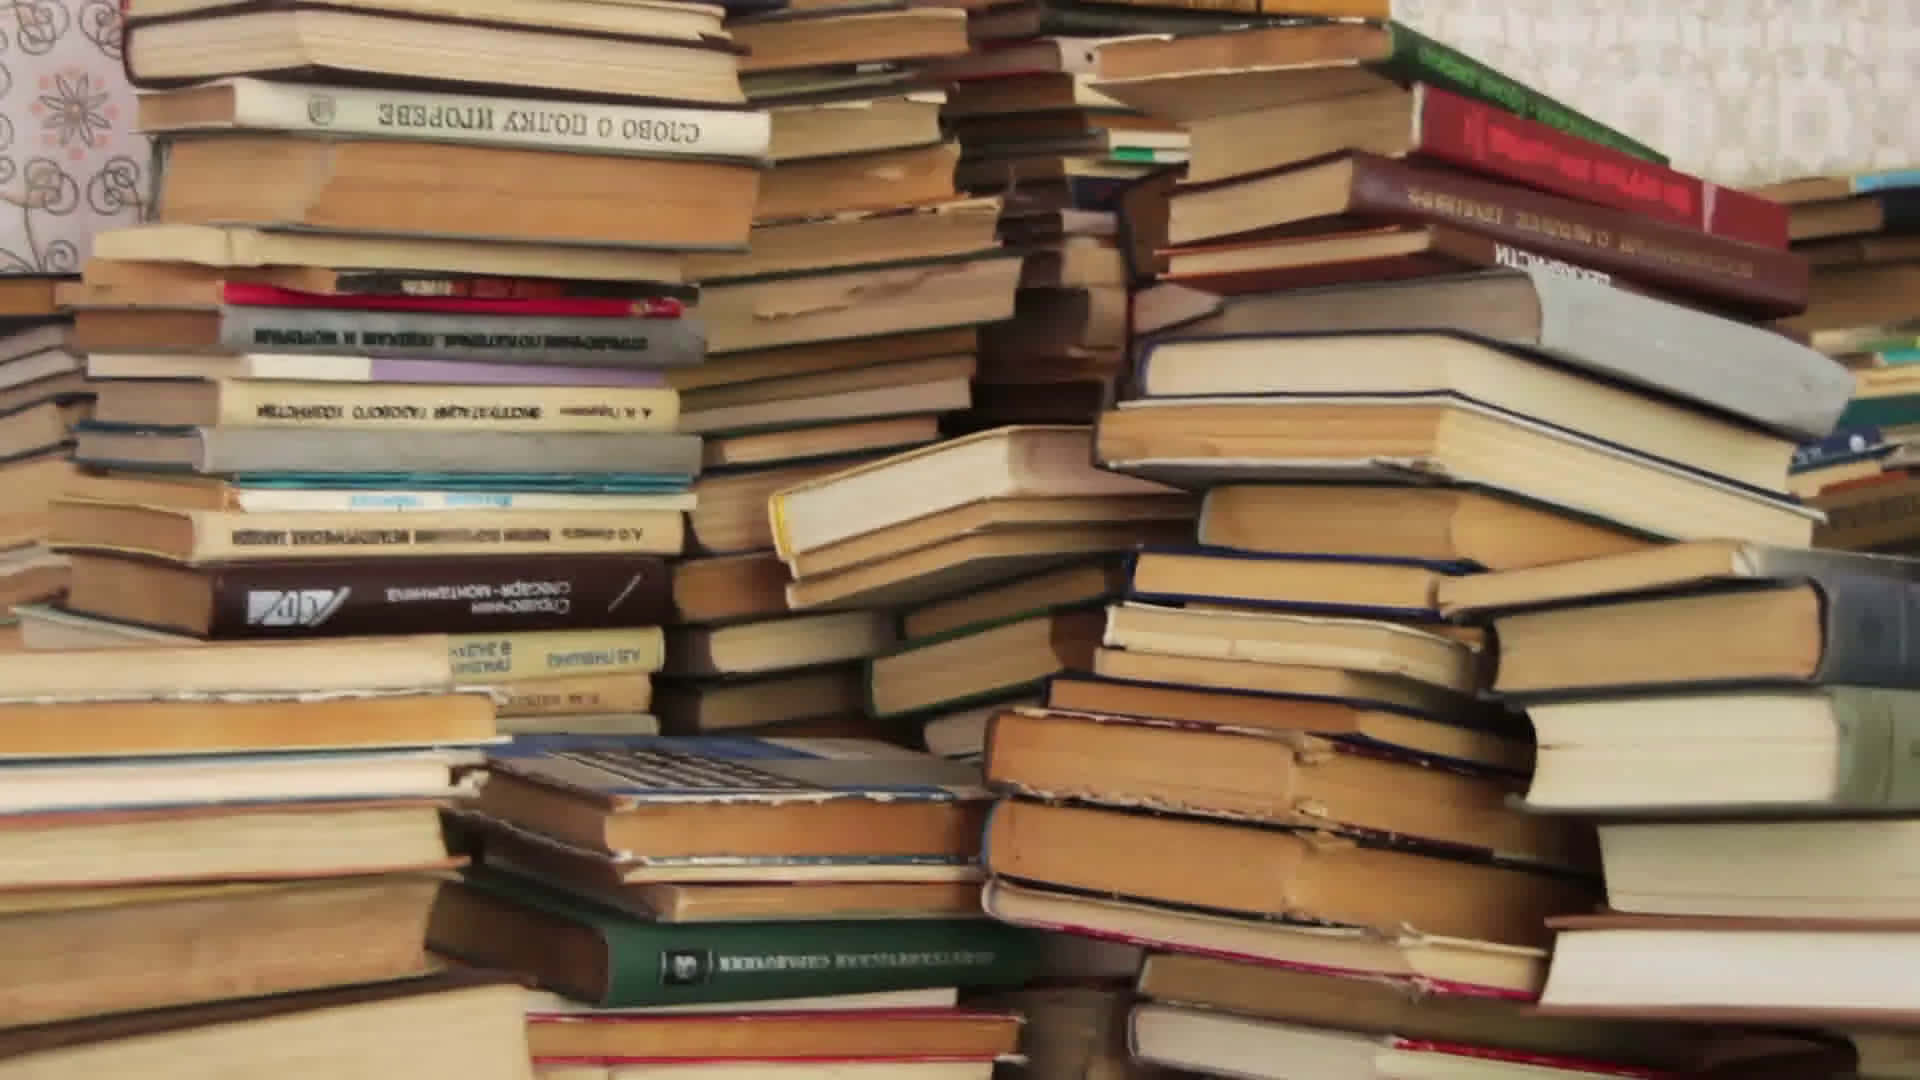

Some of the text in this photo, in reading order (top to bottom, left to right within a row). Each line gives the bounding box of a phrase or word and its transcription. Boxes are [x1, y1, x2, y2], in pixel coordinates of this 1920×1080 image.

[378, 103, 700, 143] СЛОВО О ПОЛКУ ИГОРЕВЕ
